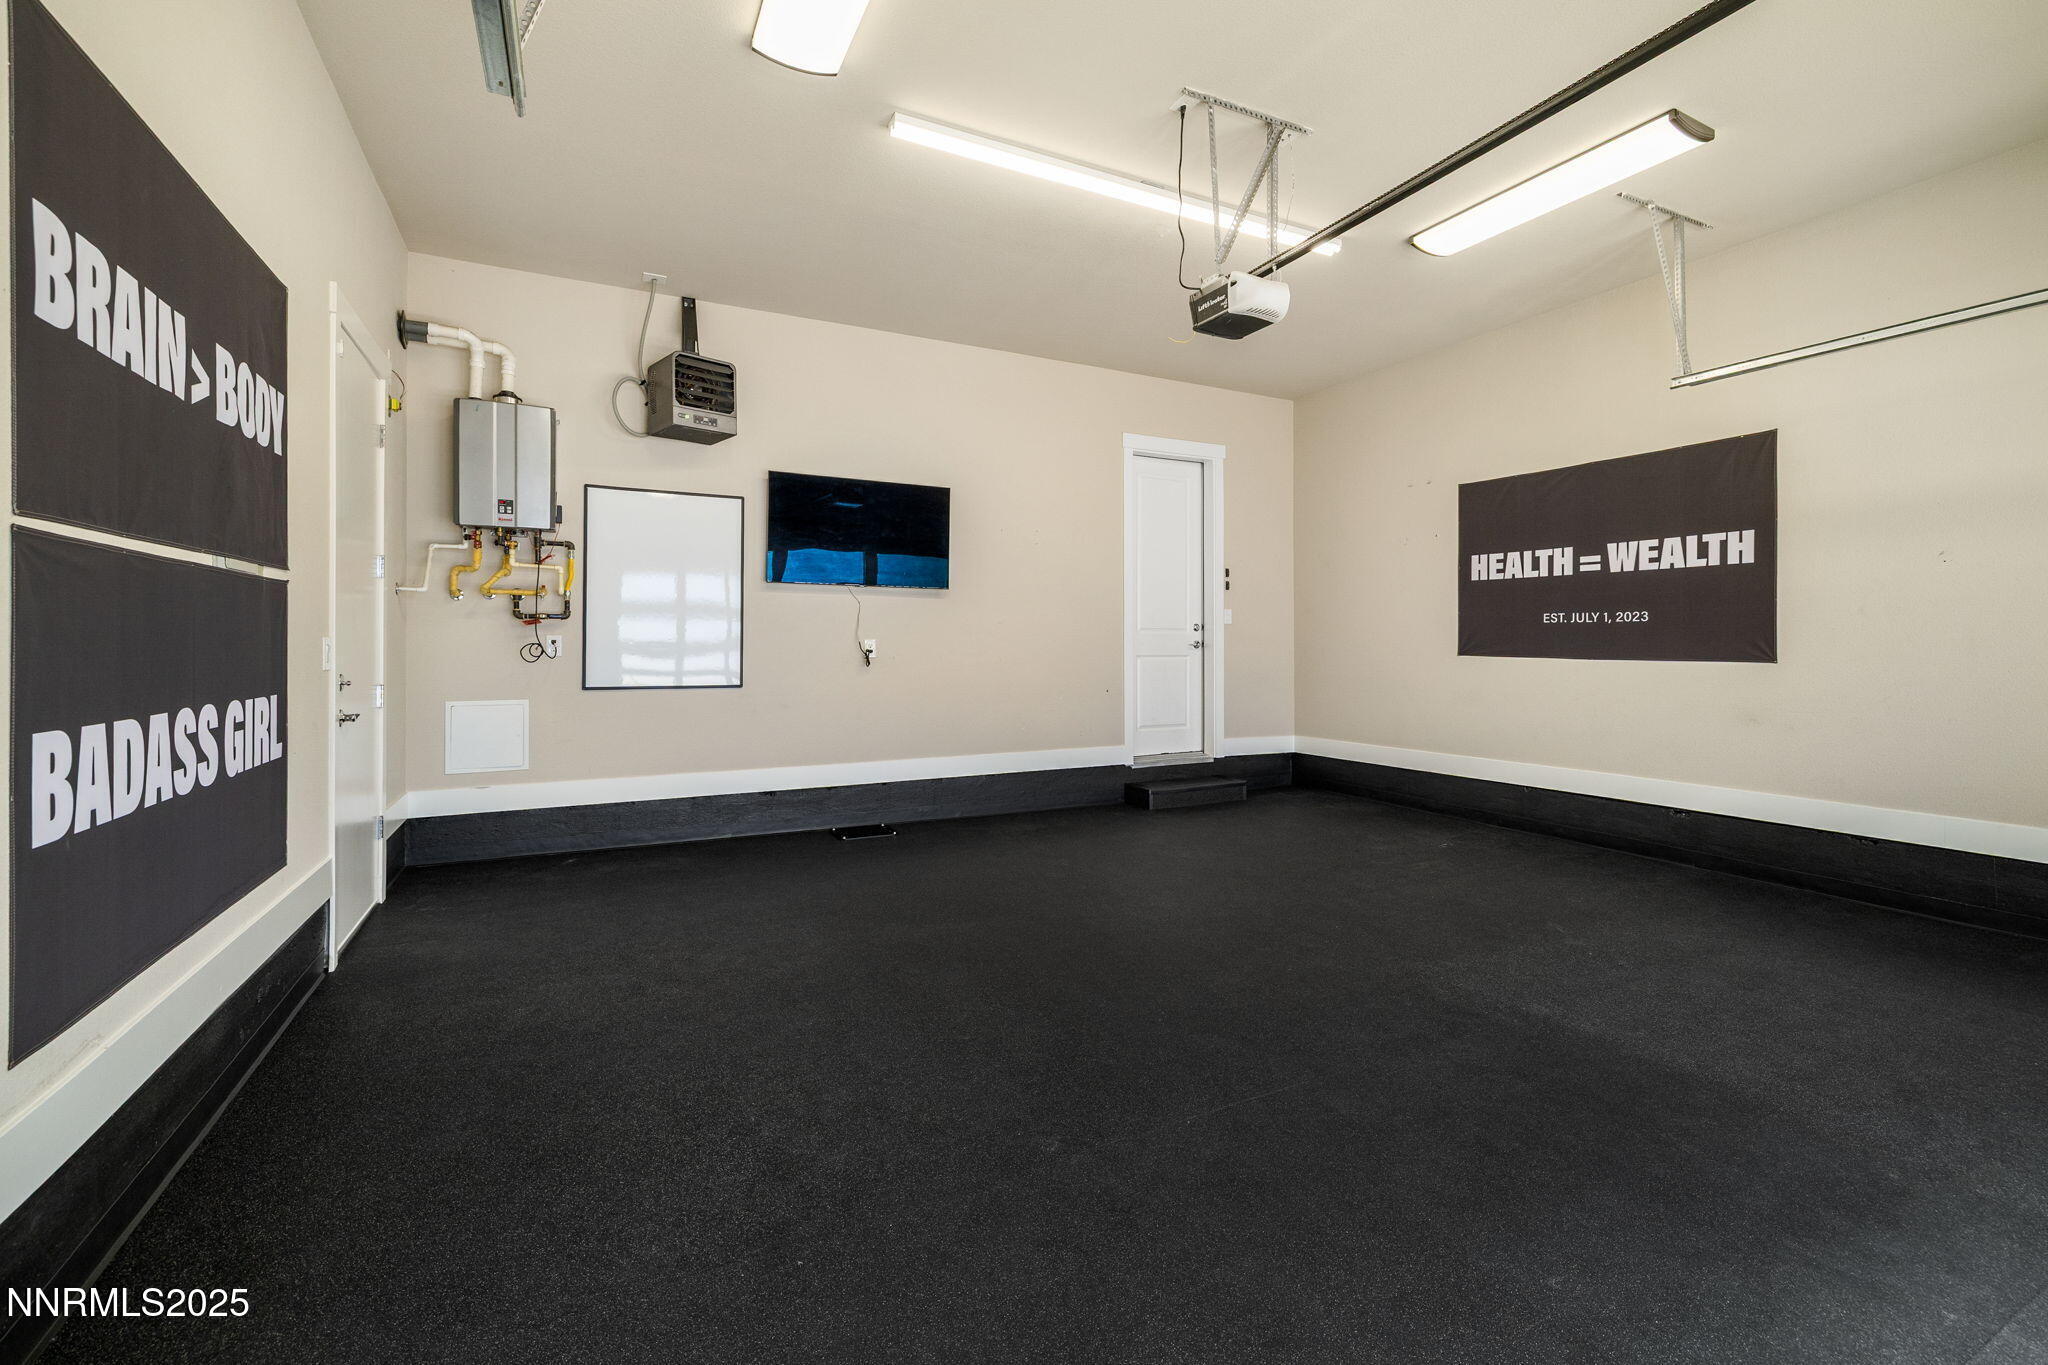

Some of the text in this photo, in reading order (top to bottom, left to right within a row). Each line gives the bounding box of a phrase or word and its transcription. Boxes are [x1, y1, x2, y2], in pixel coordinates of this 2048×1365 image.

[32, 197, 186, 401] BRAIN
[215, 342, 285, 457] BODY
[1470, 546, 1574, 581] HEALTH
[1606, 529, 1755, 573] WEALTH
[1543, 610, 1649, 624] EST. JULY 1, 2023
[31, 694, 283, 849] BADASS GIRL
